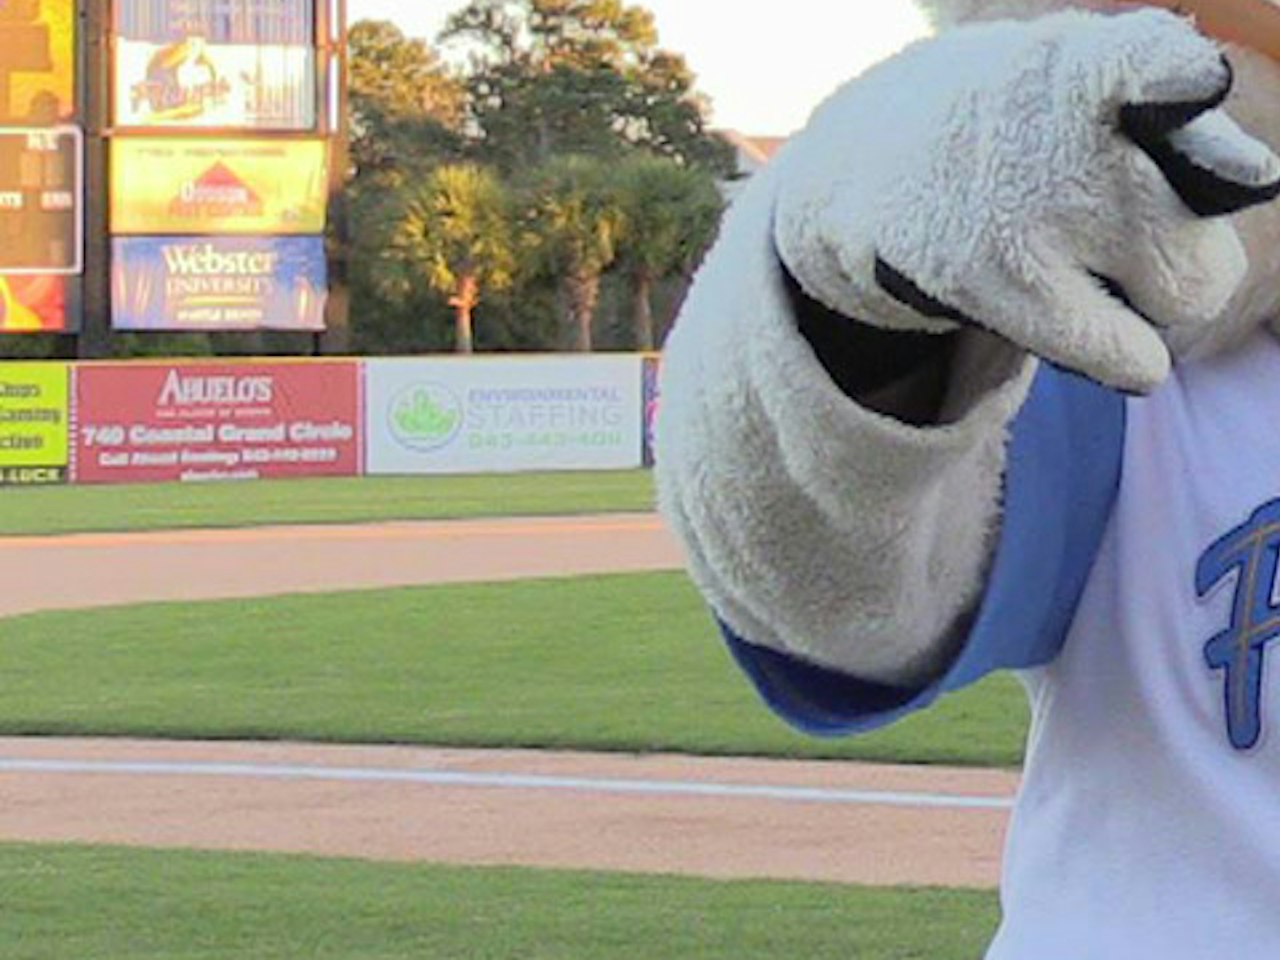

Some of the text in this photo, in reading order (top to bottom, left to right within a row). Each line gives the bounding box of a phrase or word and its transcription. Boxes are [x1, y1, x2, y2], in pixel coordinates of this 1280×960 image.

[161, 243, 278, 274] Webster
[157, 368, 273, 406] ABUELO'S
[468, 404, 624, 426] STAFFING
[129, 425, 214, 444] Coastal
[218, 423, 286, 442] Grand
[289, 421, 353, 441] Circle
